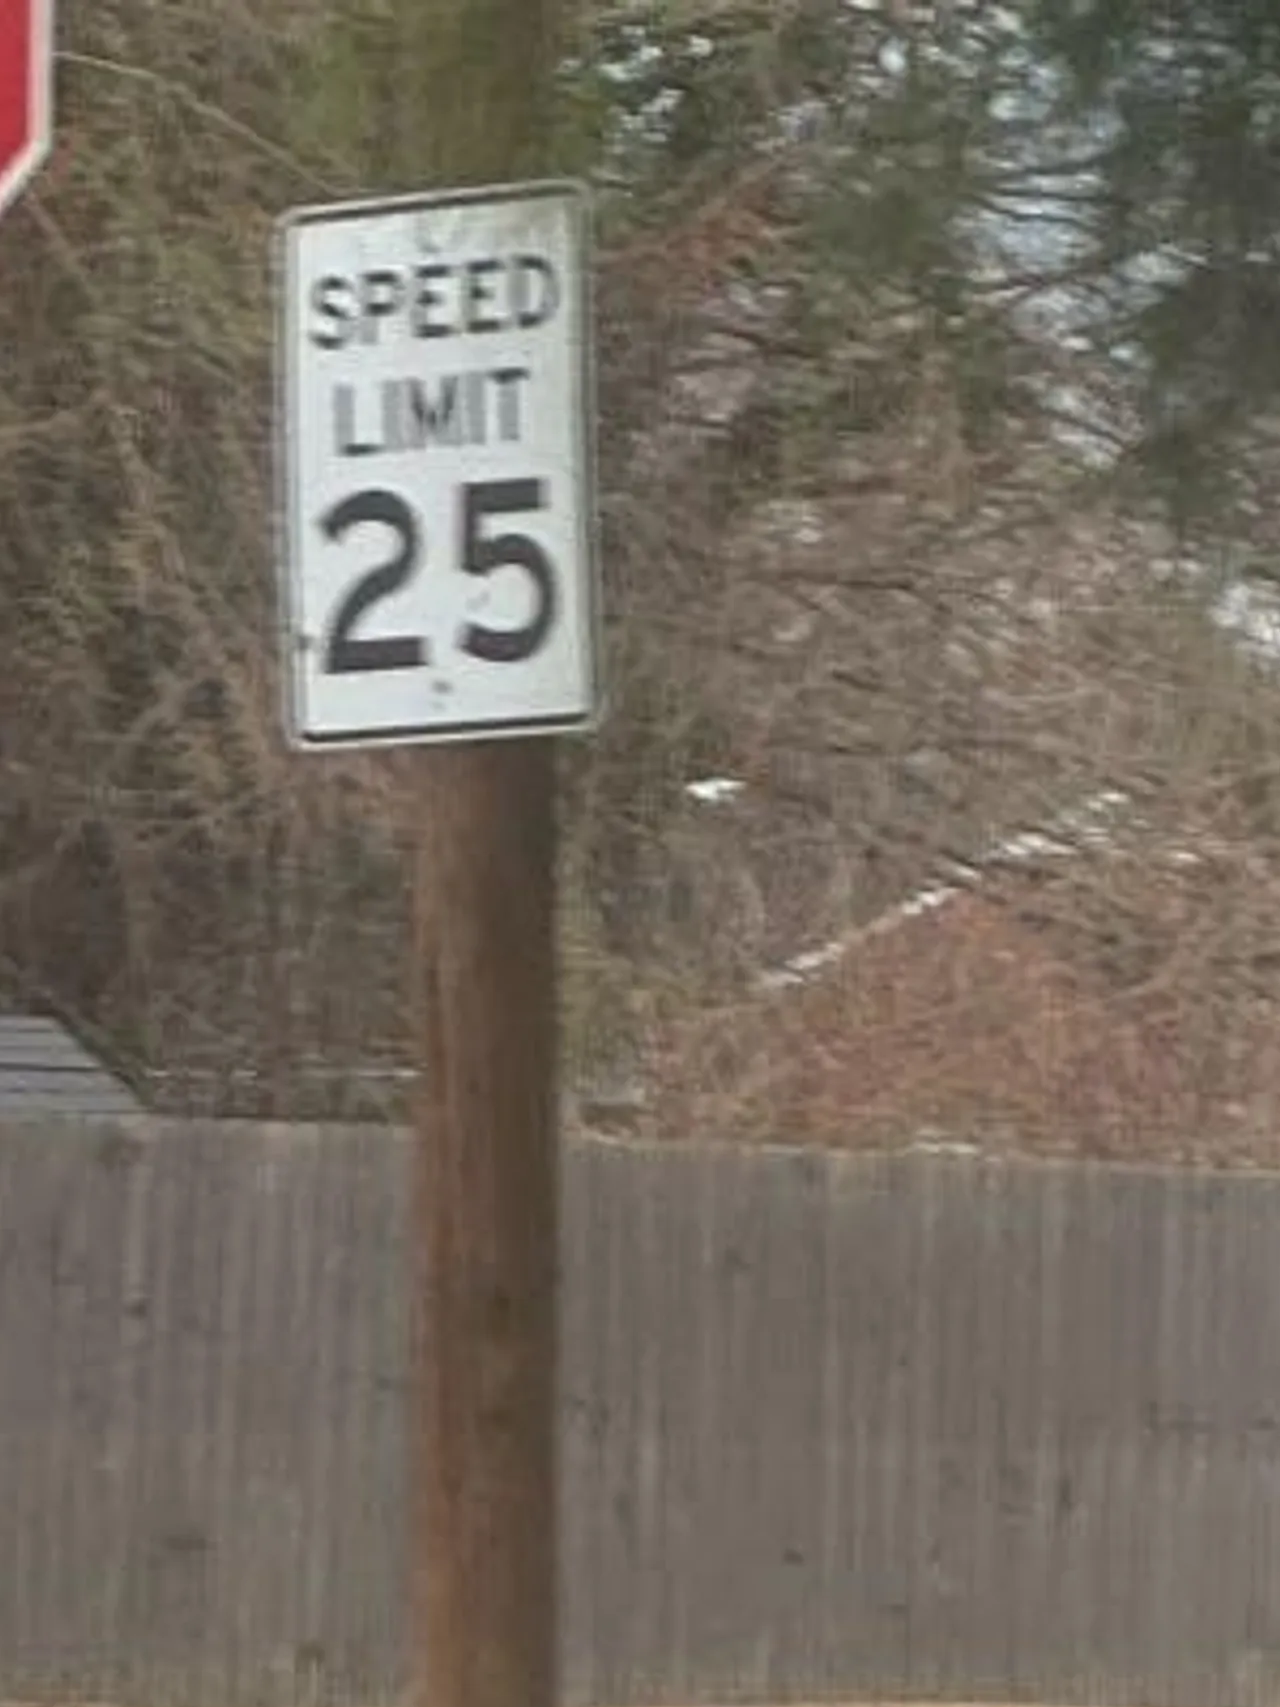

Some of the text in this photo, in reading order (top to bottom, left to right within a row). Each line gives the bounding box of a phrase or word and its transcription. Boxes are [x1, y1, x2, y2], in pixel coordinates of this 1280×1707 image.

[310, 255, 560, 350] SPEED
[331, 366, 530, 457] LIMIT
[320, 477, 558, 675] 25
